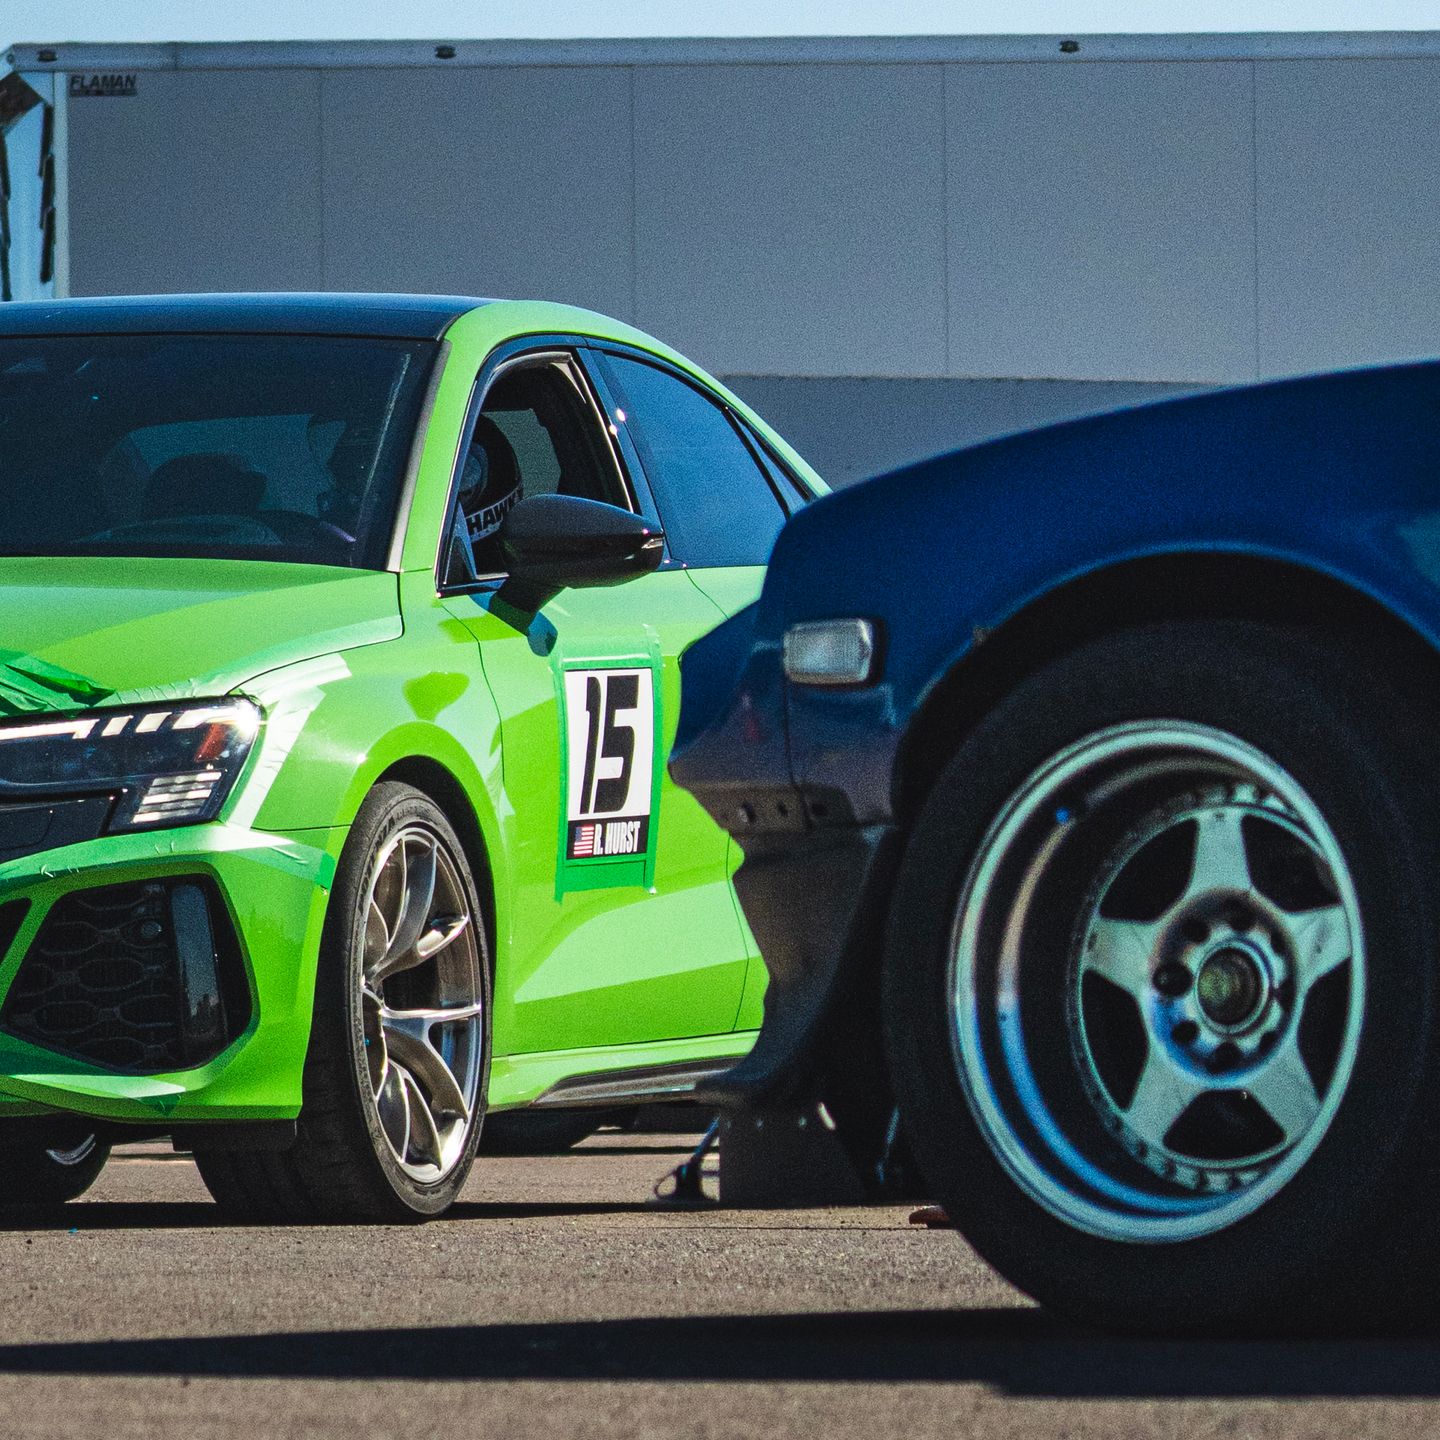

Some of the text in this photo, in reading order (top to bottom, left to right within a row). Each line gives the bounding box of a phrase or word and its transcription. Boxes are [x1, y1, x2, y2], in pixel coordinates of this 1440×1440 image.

[69, 73, 137, 89] FLAMAN
[579, 674, 640, 815] 15
[593, 820, 641, 856] R. HURST
